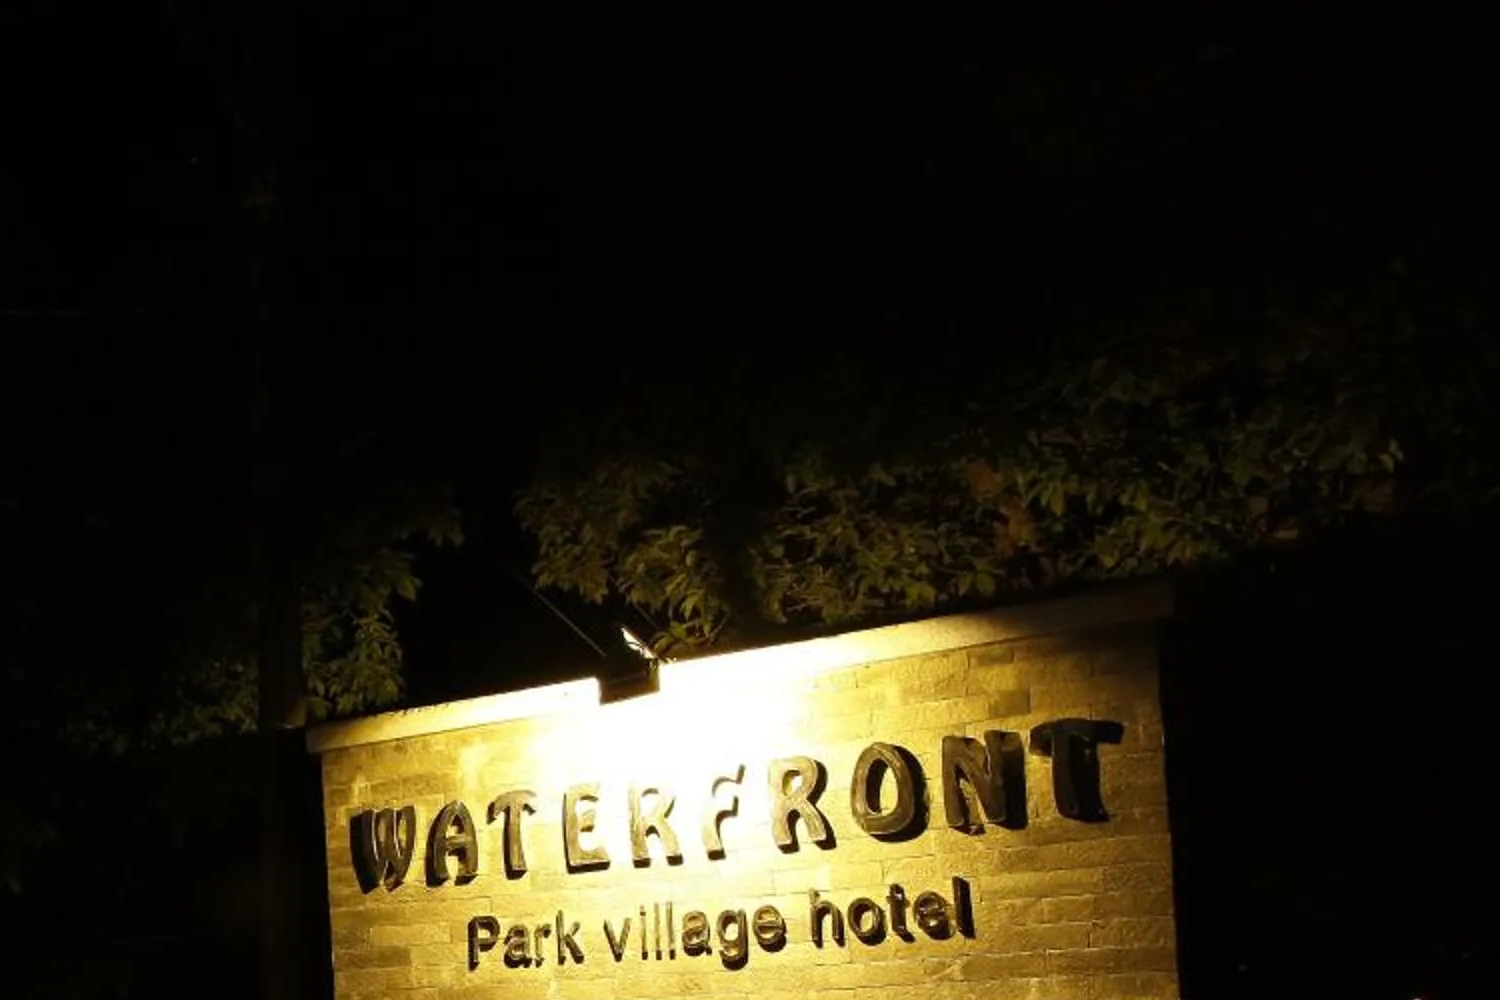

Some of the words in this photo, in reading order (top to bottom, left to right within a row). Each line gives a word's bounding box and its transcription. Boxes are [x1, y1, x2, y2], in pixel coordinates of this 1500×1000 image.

[349, 717, 1125, 893] WATERFRONT
[467, 910, 584, 970] Park
[603, 900, 787, 970] village
[808, 876, 977, 951] hotel
